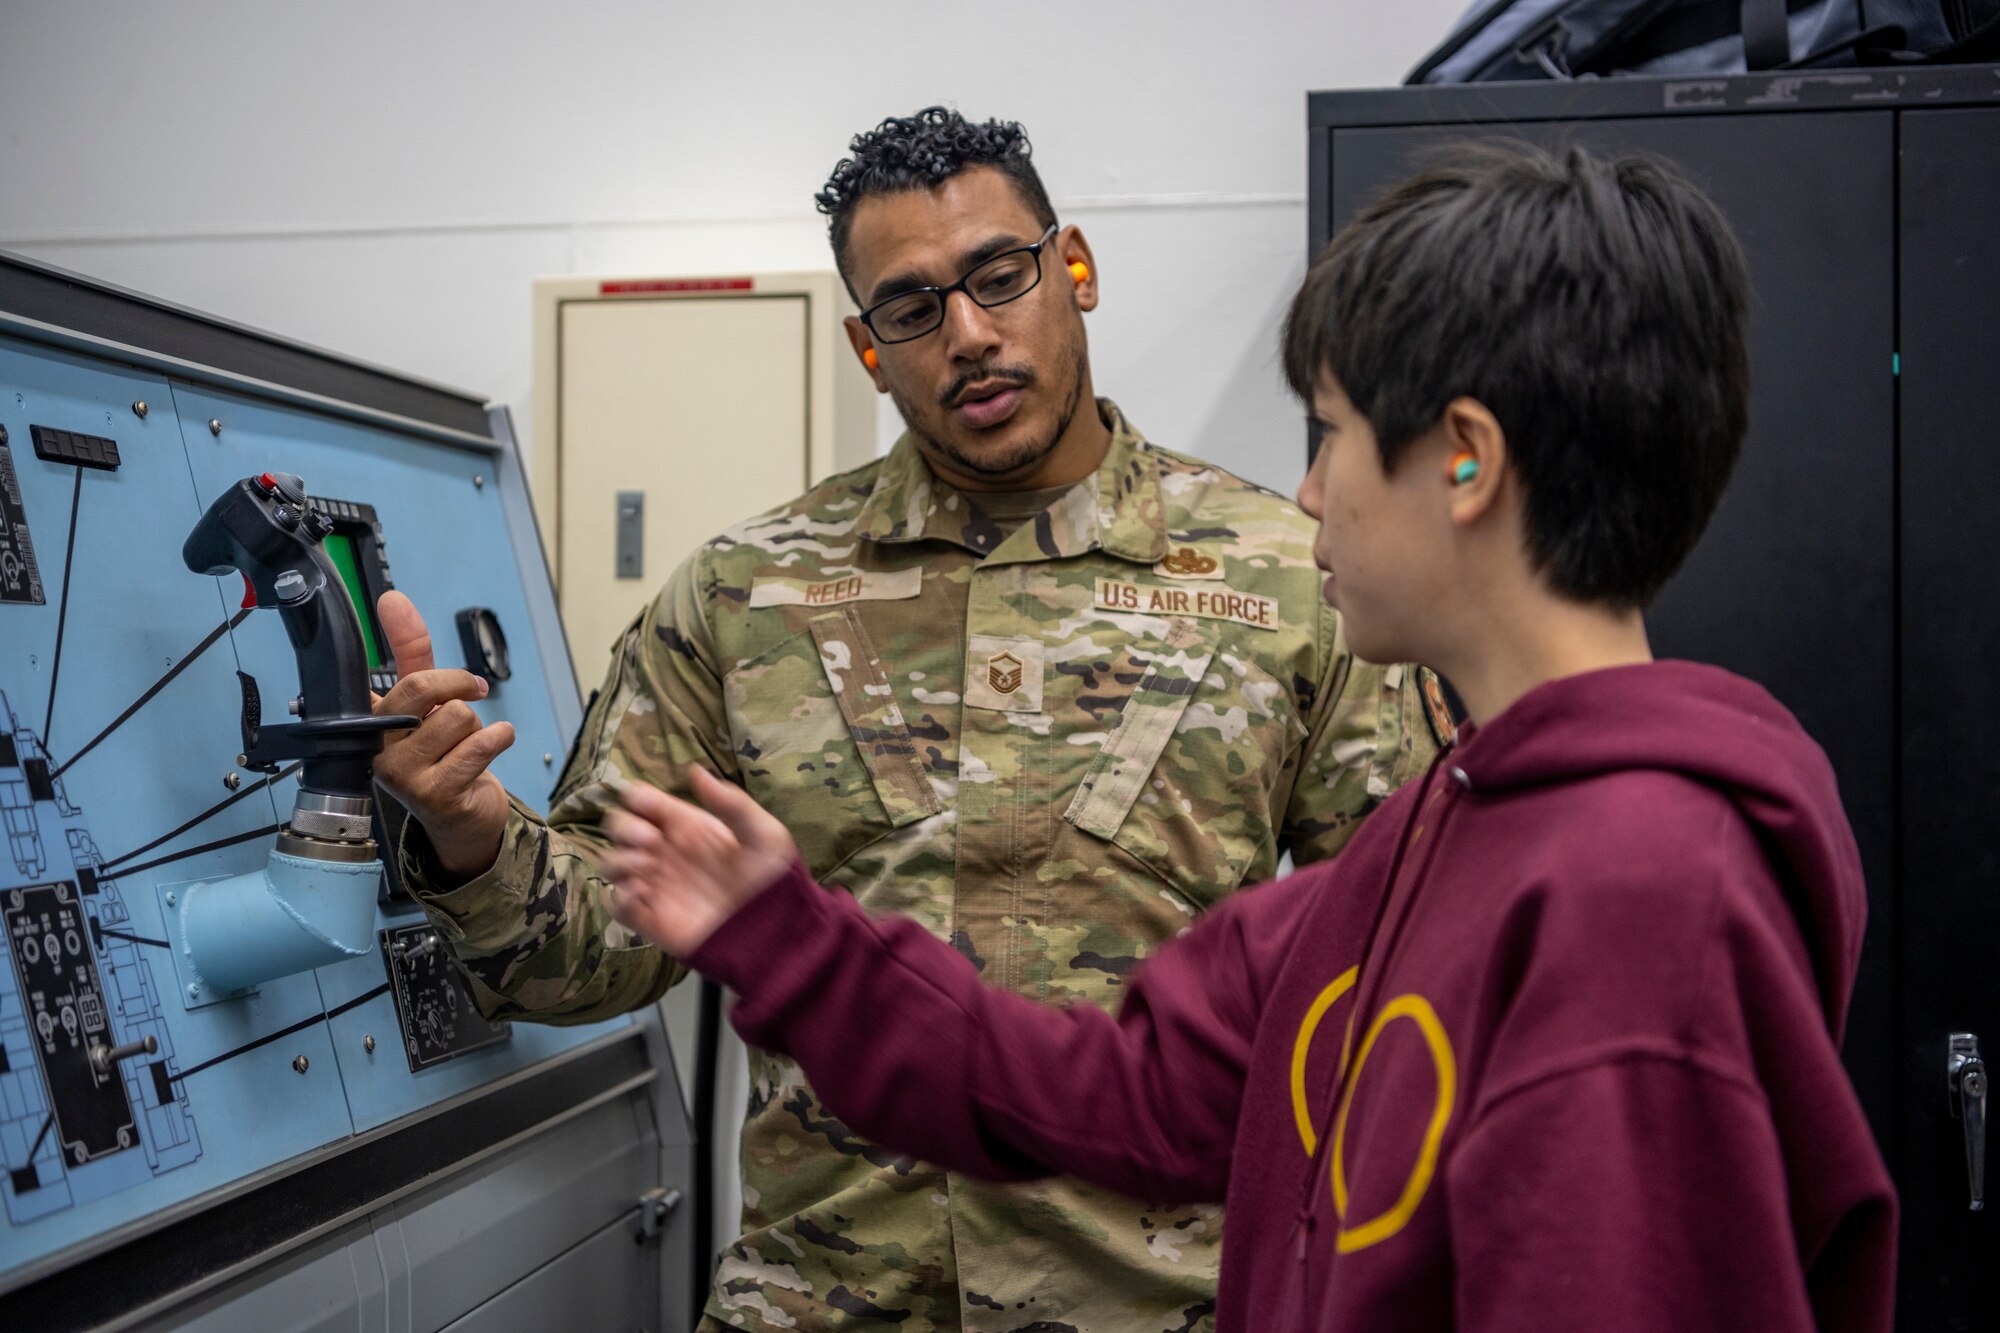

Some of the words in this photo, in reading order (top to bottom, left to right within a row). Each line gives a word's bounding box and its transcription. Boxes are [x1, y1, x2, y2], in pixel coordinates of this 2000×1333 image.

[804, 576, 862, 603] REED
[1103, 582, 1141, 609] U.S.
[1150, 589, 1190, 612] AIR
[1197, 591, 1270, 625] FORCE
